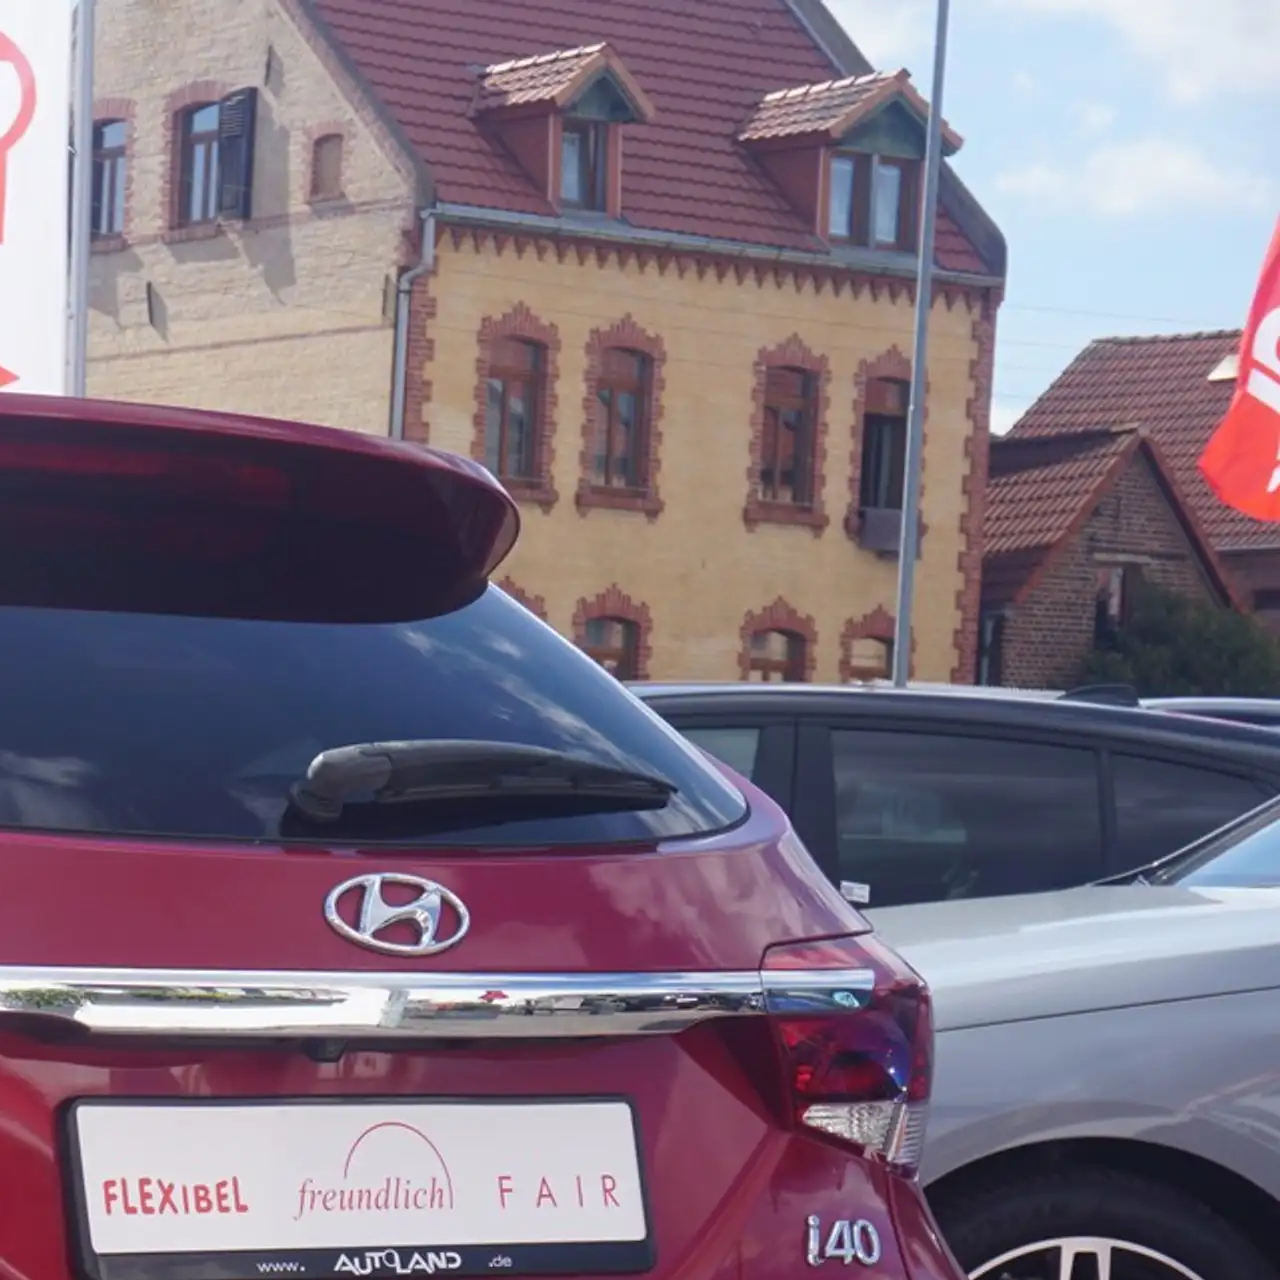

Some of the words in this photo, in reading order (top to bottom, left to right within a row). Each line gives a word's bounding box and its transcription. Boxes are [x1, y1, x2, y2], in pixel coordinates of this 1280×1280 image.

[103, 1176, 249, 1216] FLEXIBEL
[293, 1177, 445, 1220] freundlich
[255, 1260, 306, 1273] www.
[333, 1249, 462, 1276] AUTOLAND
[806, 1214, 881, 1267] i40
